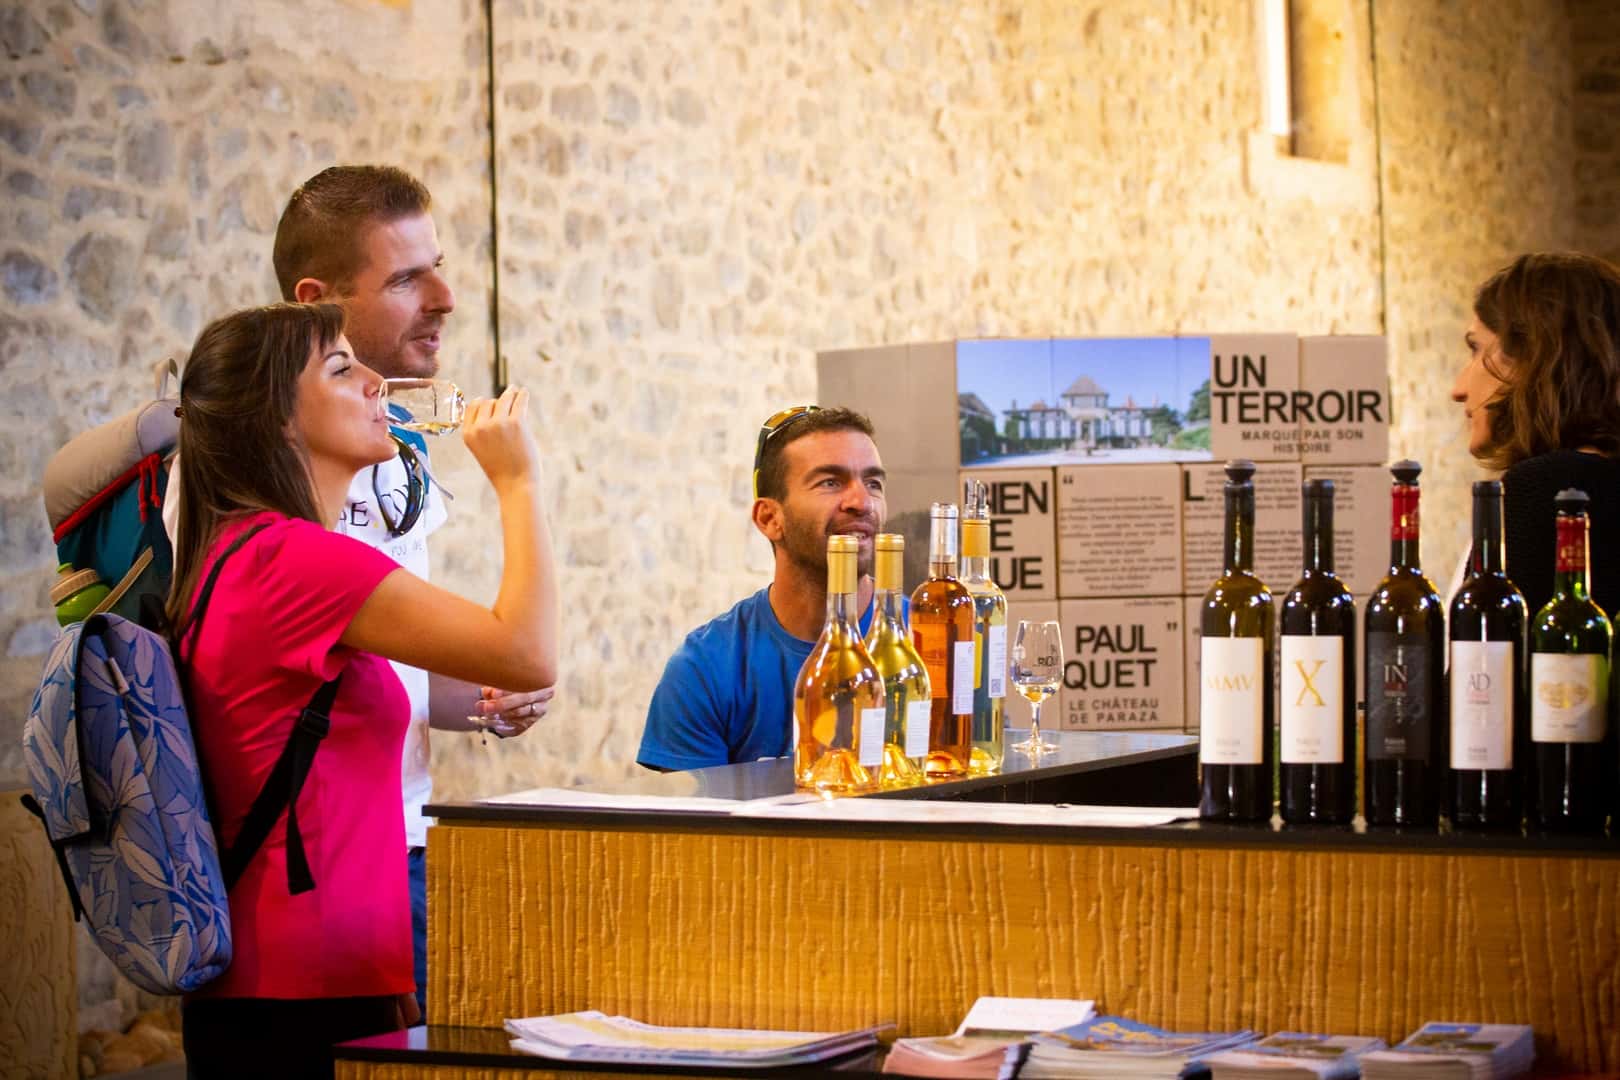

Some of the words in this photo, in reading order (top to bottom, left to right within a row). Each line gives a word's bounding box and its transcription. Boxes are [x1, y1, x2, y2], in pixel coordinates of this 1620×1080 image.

[1214, 355, 1266, 388] UN
[1212, 389, 1383, 424] TERROIR
[1273, 442, 1331, 454] HISTOIRE
[1304, 429, 1331, 441] PAR
[1337, 428, 1364, 440] SON
[990, 518, 1014, 552] E
[990, 556, 1044, 591] UE
[1075, 624, 1158, 655] PAUL
[1292, 658, 1328, 707] X
[1069, 700, 1086, 711] LE
[1069, 713, 1088, 724] DE
[1096, 711, 1158, 724] PARAZA
